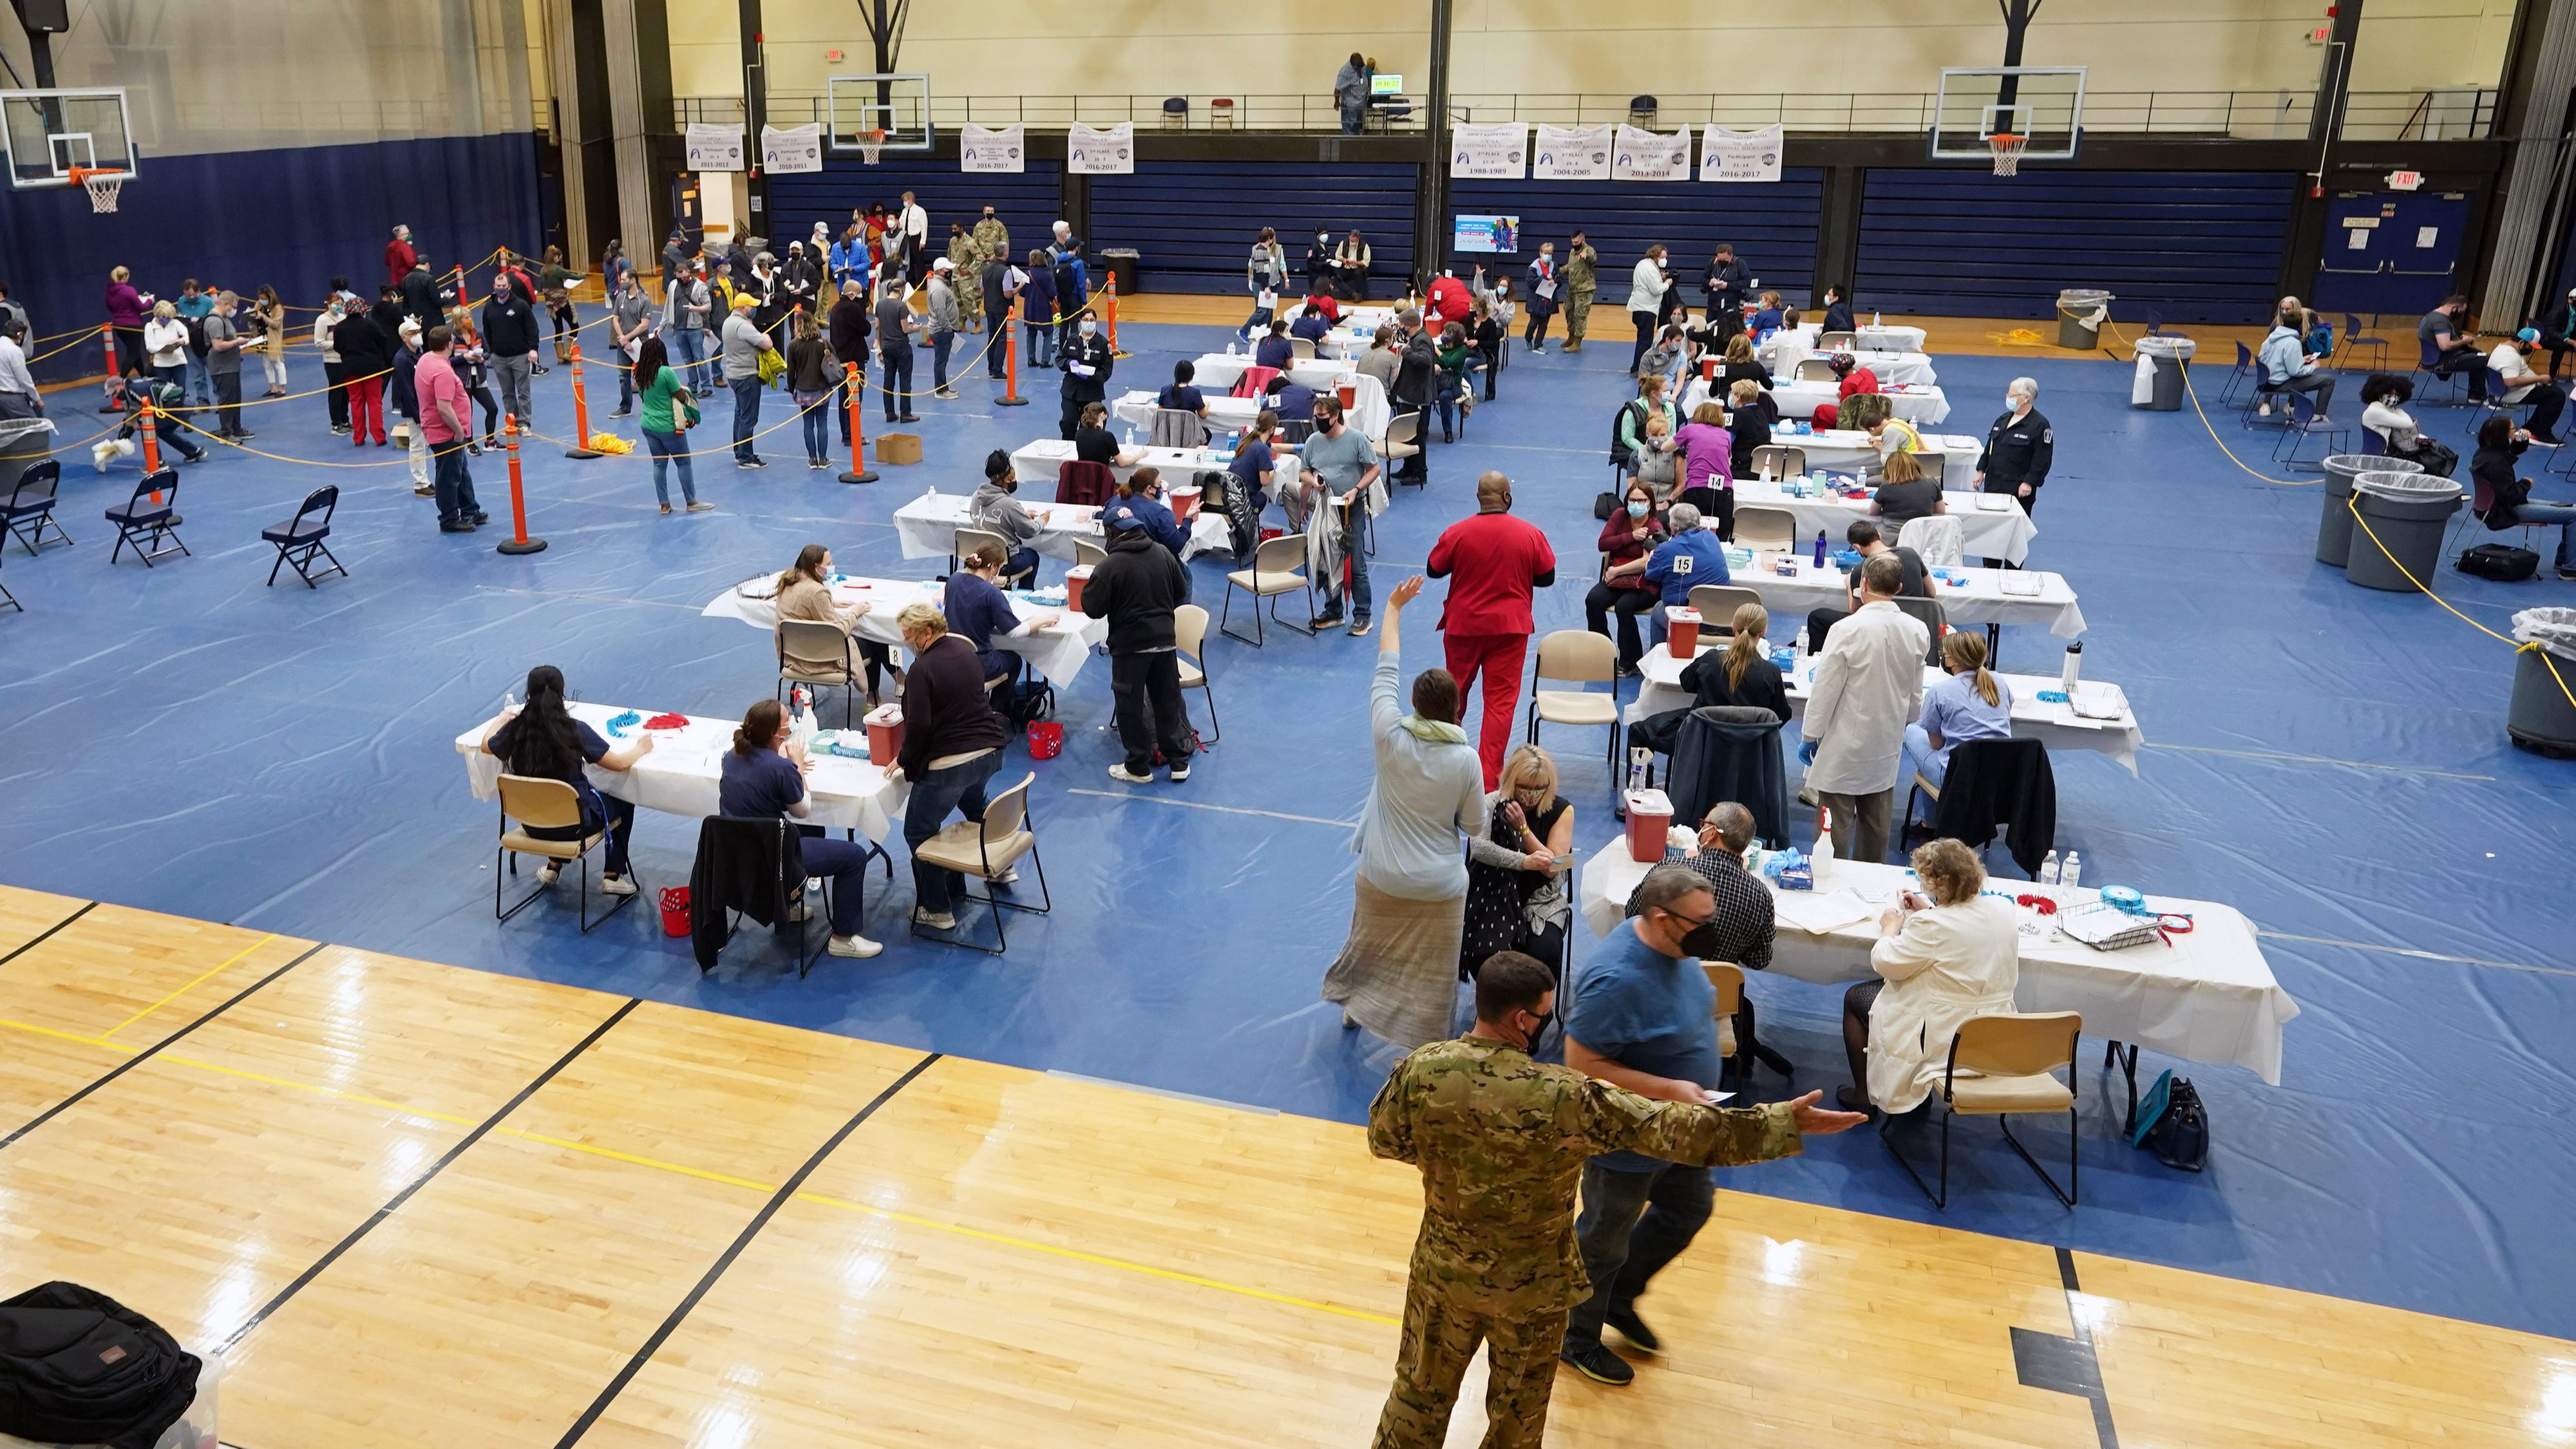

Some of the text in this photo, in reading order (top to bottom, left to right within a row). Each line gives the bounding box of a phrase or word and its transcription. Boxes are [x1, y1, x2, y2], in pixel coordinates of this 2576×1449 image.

[2315, 28, 2331, 39] EX
[2397, 172, 2416, 185] EXIT
[1273, 397, 1277, 405] 5
[1197, 453, 1201, 463] 6
[1712, 477, 1721, 487] 14
[1095, 522, 1100, 532] 7
[1678, 559, 1690, 570] 15
[893, 650, 898, 662] 8
